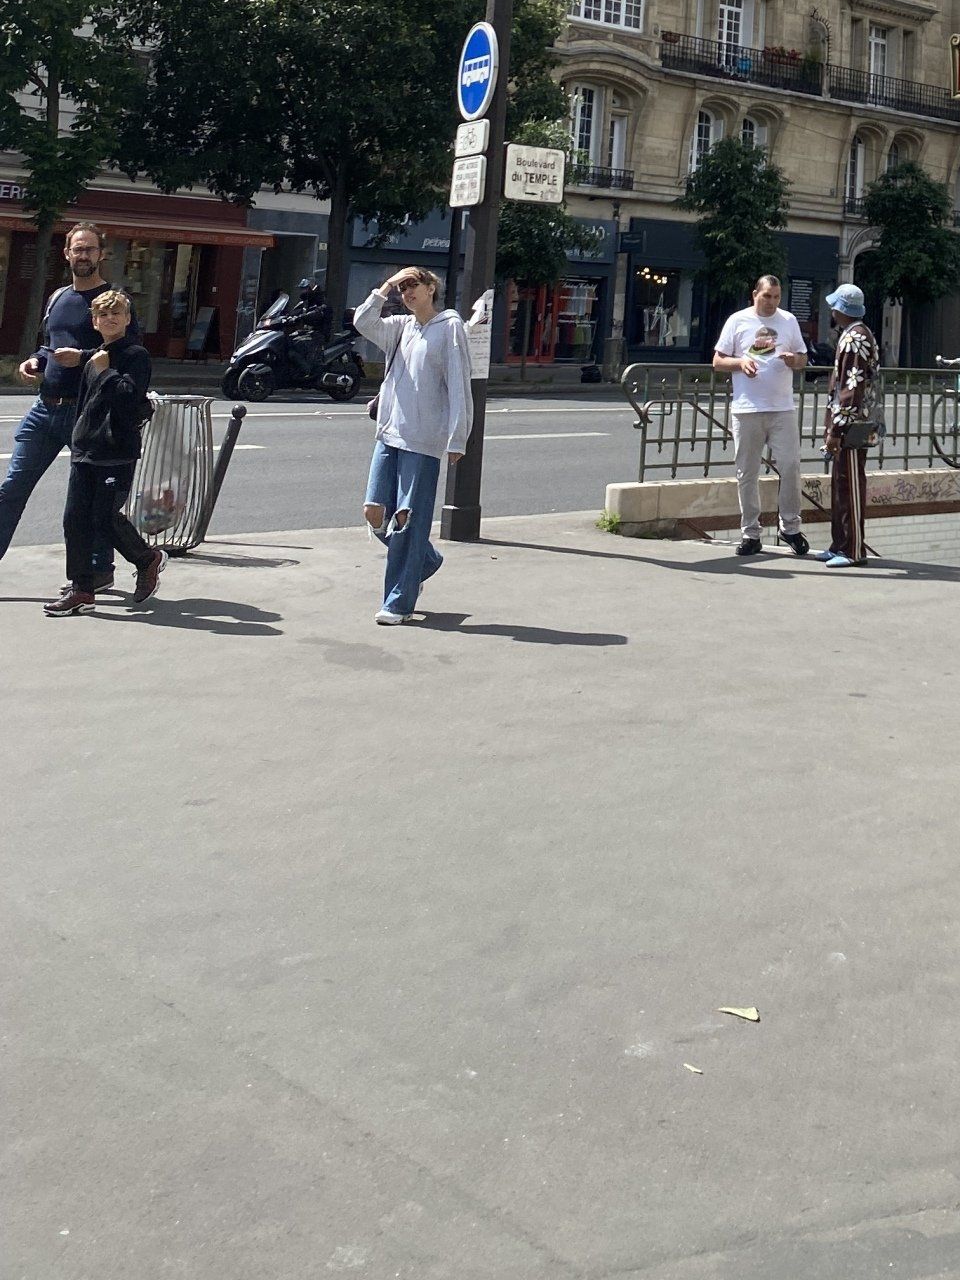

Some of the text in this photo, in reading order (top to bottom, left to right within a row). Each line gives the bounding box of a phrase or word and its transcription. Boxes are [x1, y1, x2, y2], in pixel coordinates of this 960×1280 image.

[516, 157, 556, 170] Boulevard
[511, 171, 558, 186] du TEMPLE
